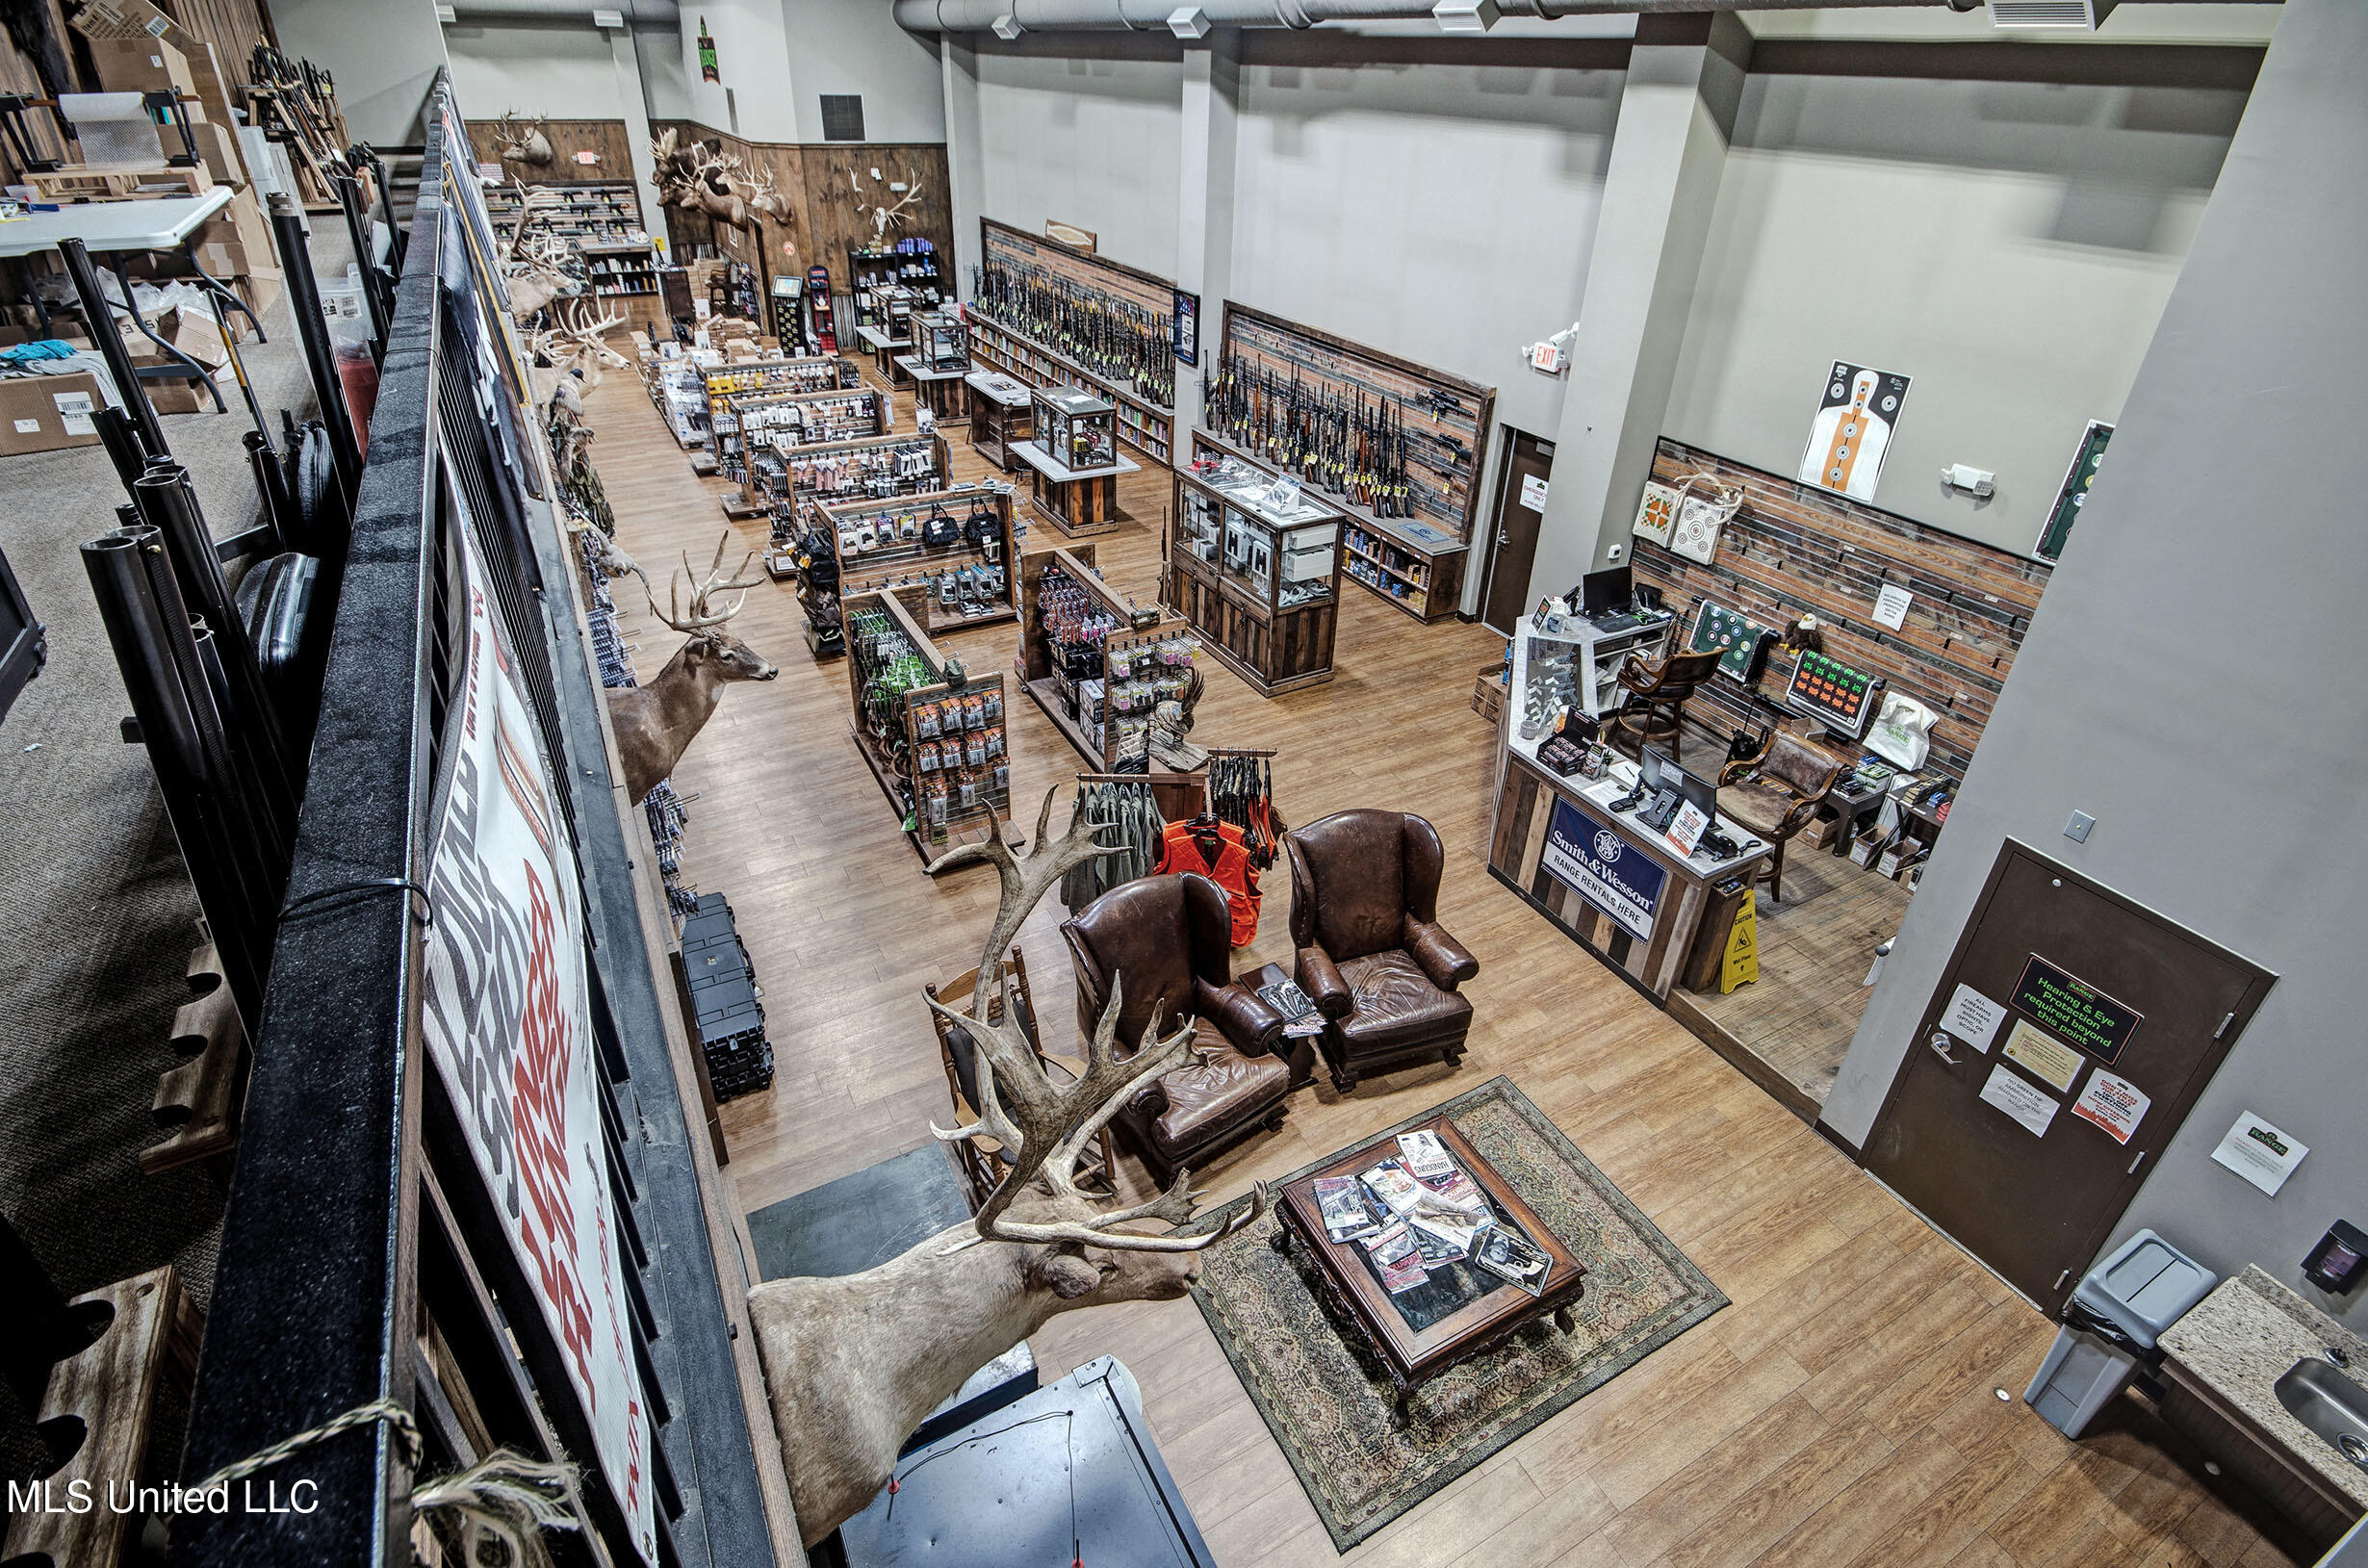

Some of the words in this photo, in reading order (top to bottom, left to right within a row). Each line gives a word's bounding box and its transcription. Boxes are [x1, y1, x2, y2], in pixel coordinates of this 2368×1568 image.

[1535, 346, 1556, 367] EXIT
[1553, 831, 1589, 866] Smith
[1554, 855, 1581, 880] RANGE
[1581, 875, 1616, 907] RENTALS
[1617, 902, 1640, 925] HERE
[1734, 913, 1752, 926] CAUTION
[2038, 977, 2080, 1008] Hearing
[2083, 1004, 2092, 1014] &
[2094, 1011, 2115, 1027] Eye
[2070, 983, 2094, 1000] RANGE
[1960, 1003, 1975, 1014] MUST
[1976, 1012, 1990, 1023] HAVE
[1965, 998, 1991, 1016] FIREARMS
[2043, 990, 2100, 1030] Protection
[1958, 1021, 1977, 1035] SCOPE
[2023, 992, 2071, 1022] required
[2072, 1019, 2112, 1047] beyond
[2037, 1010, 2057, 1027] this
[2059, 1024, 2088, 1045] point
[512, 859, 563, 1330] LONGER
[2004, 1083, 2039, 1107] AMMUNITION
[2016, 1083, 2033, 1095] GREEN
[2251, 1129, 2286, 1153] RANGE
[1413, 1161, 1449, 1173] HANDGUNS
